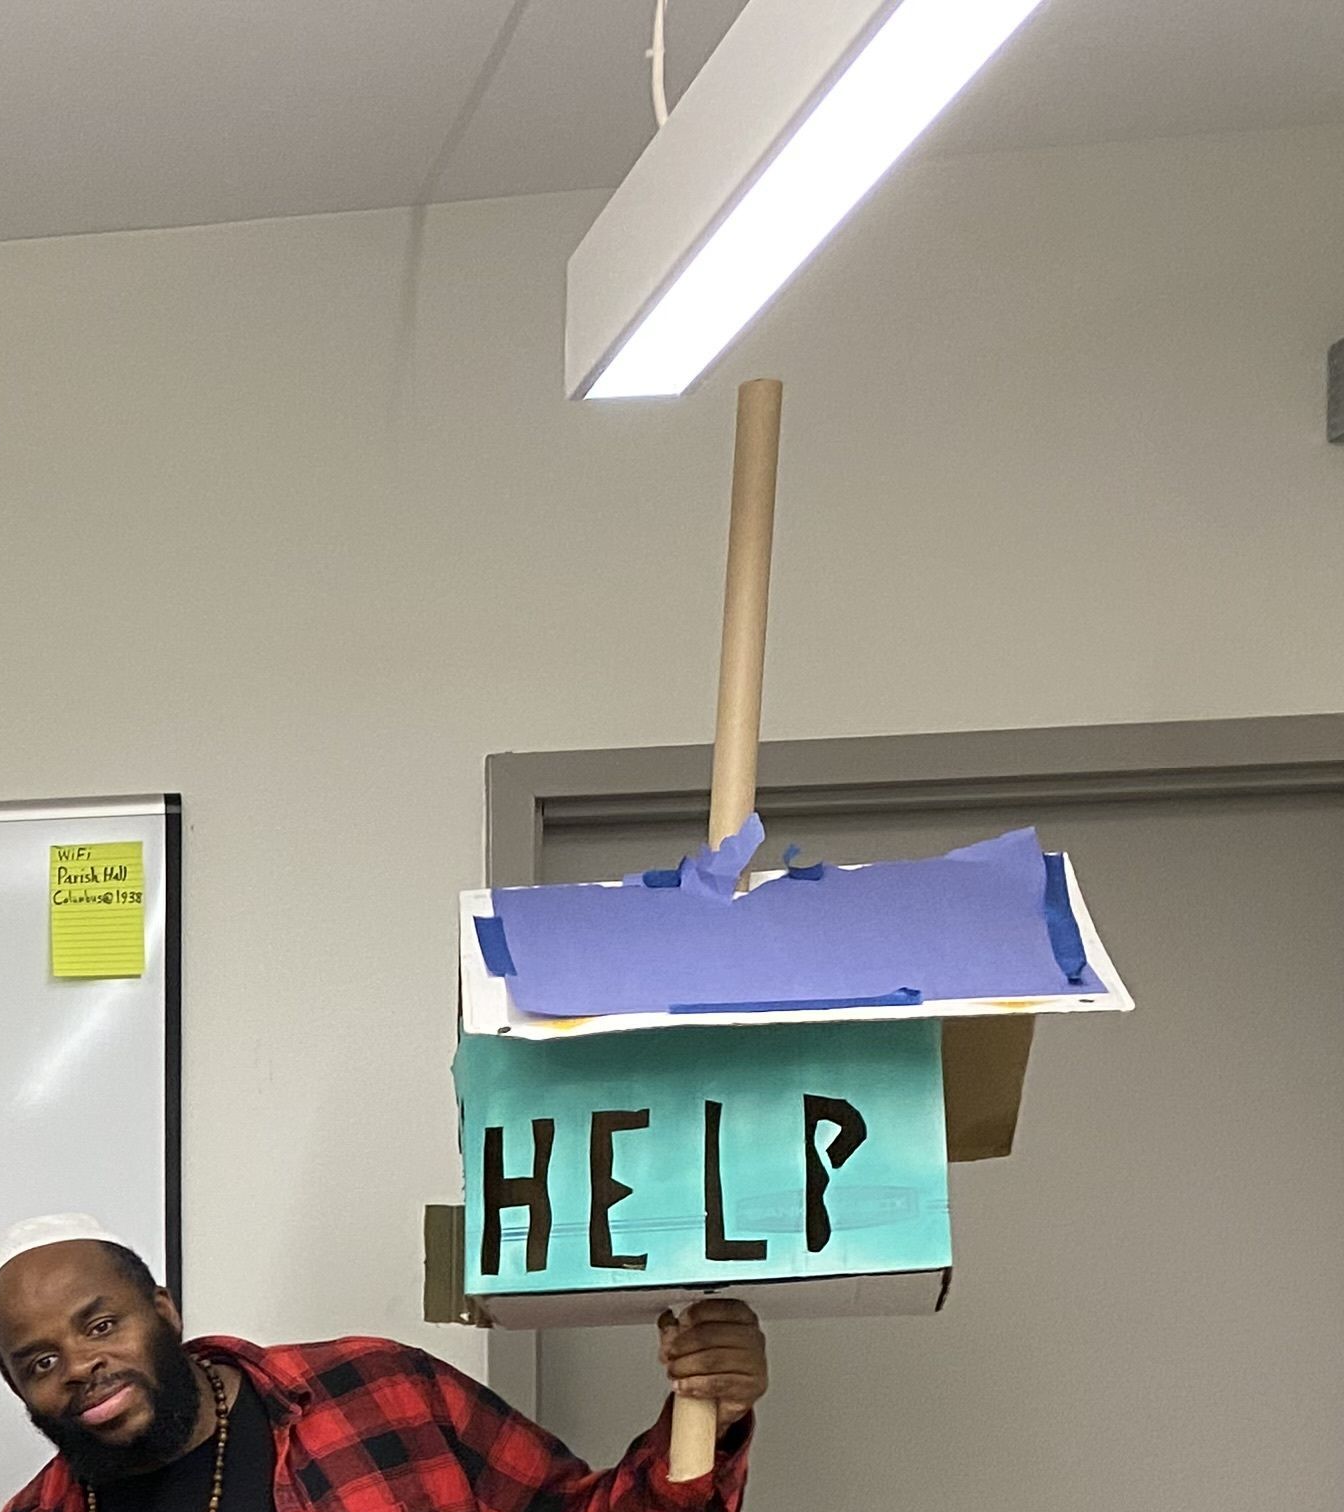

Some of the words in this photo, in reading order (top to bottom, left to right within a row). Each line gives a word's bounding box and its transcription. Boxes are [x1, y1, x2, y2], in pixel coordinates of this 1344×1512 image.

[57, 866, 100, 885] Parish
[103, 865, 128, 882] Hall
[480, 1093, 868, 1277] HELP
